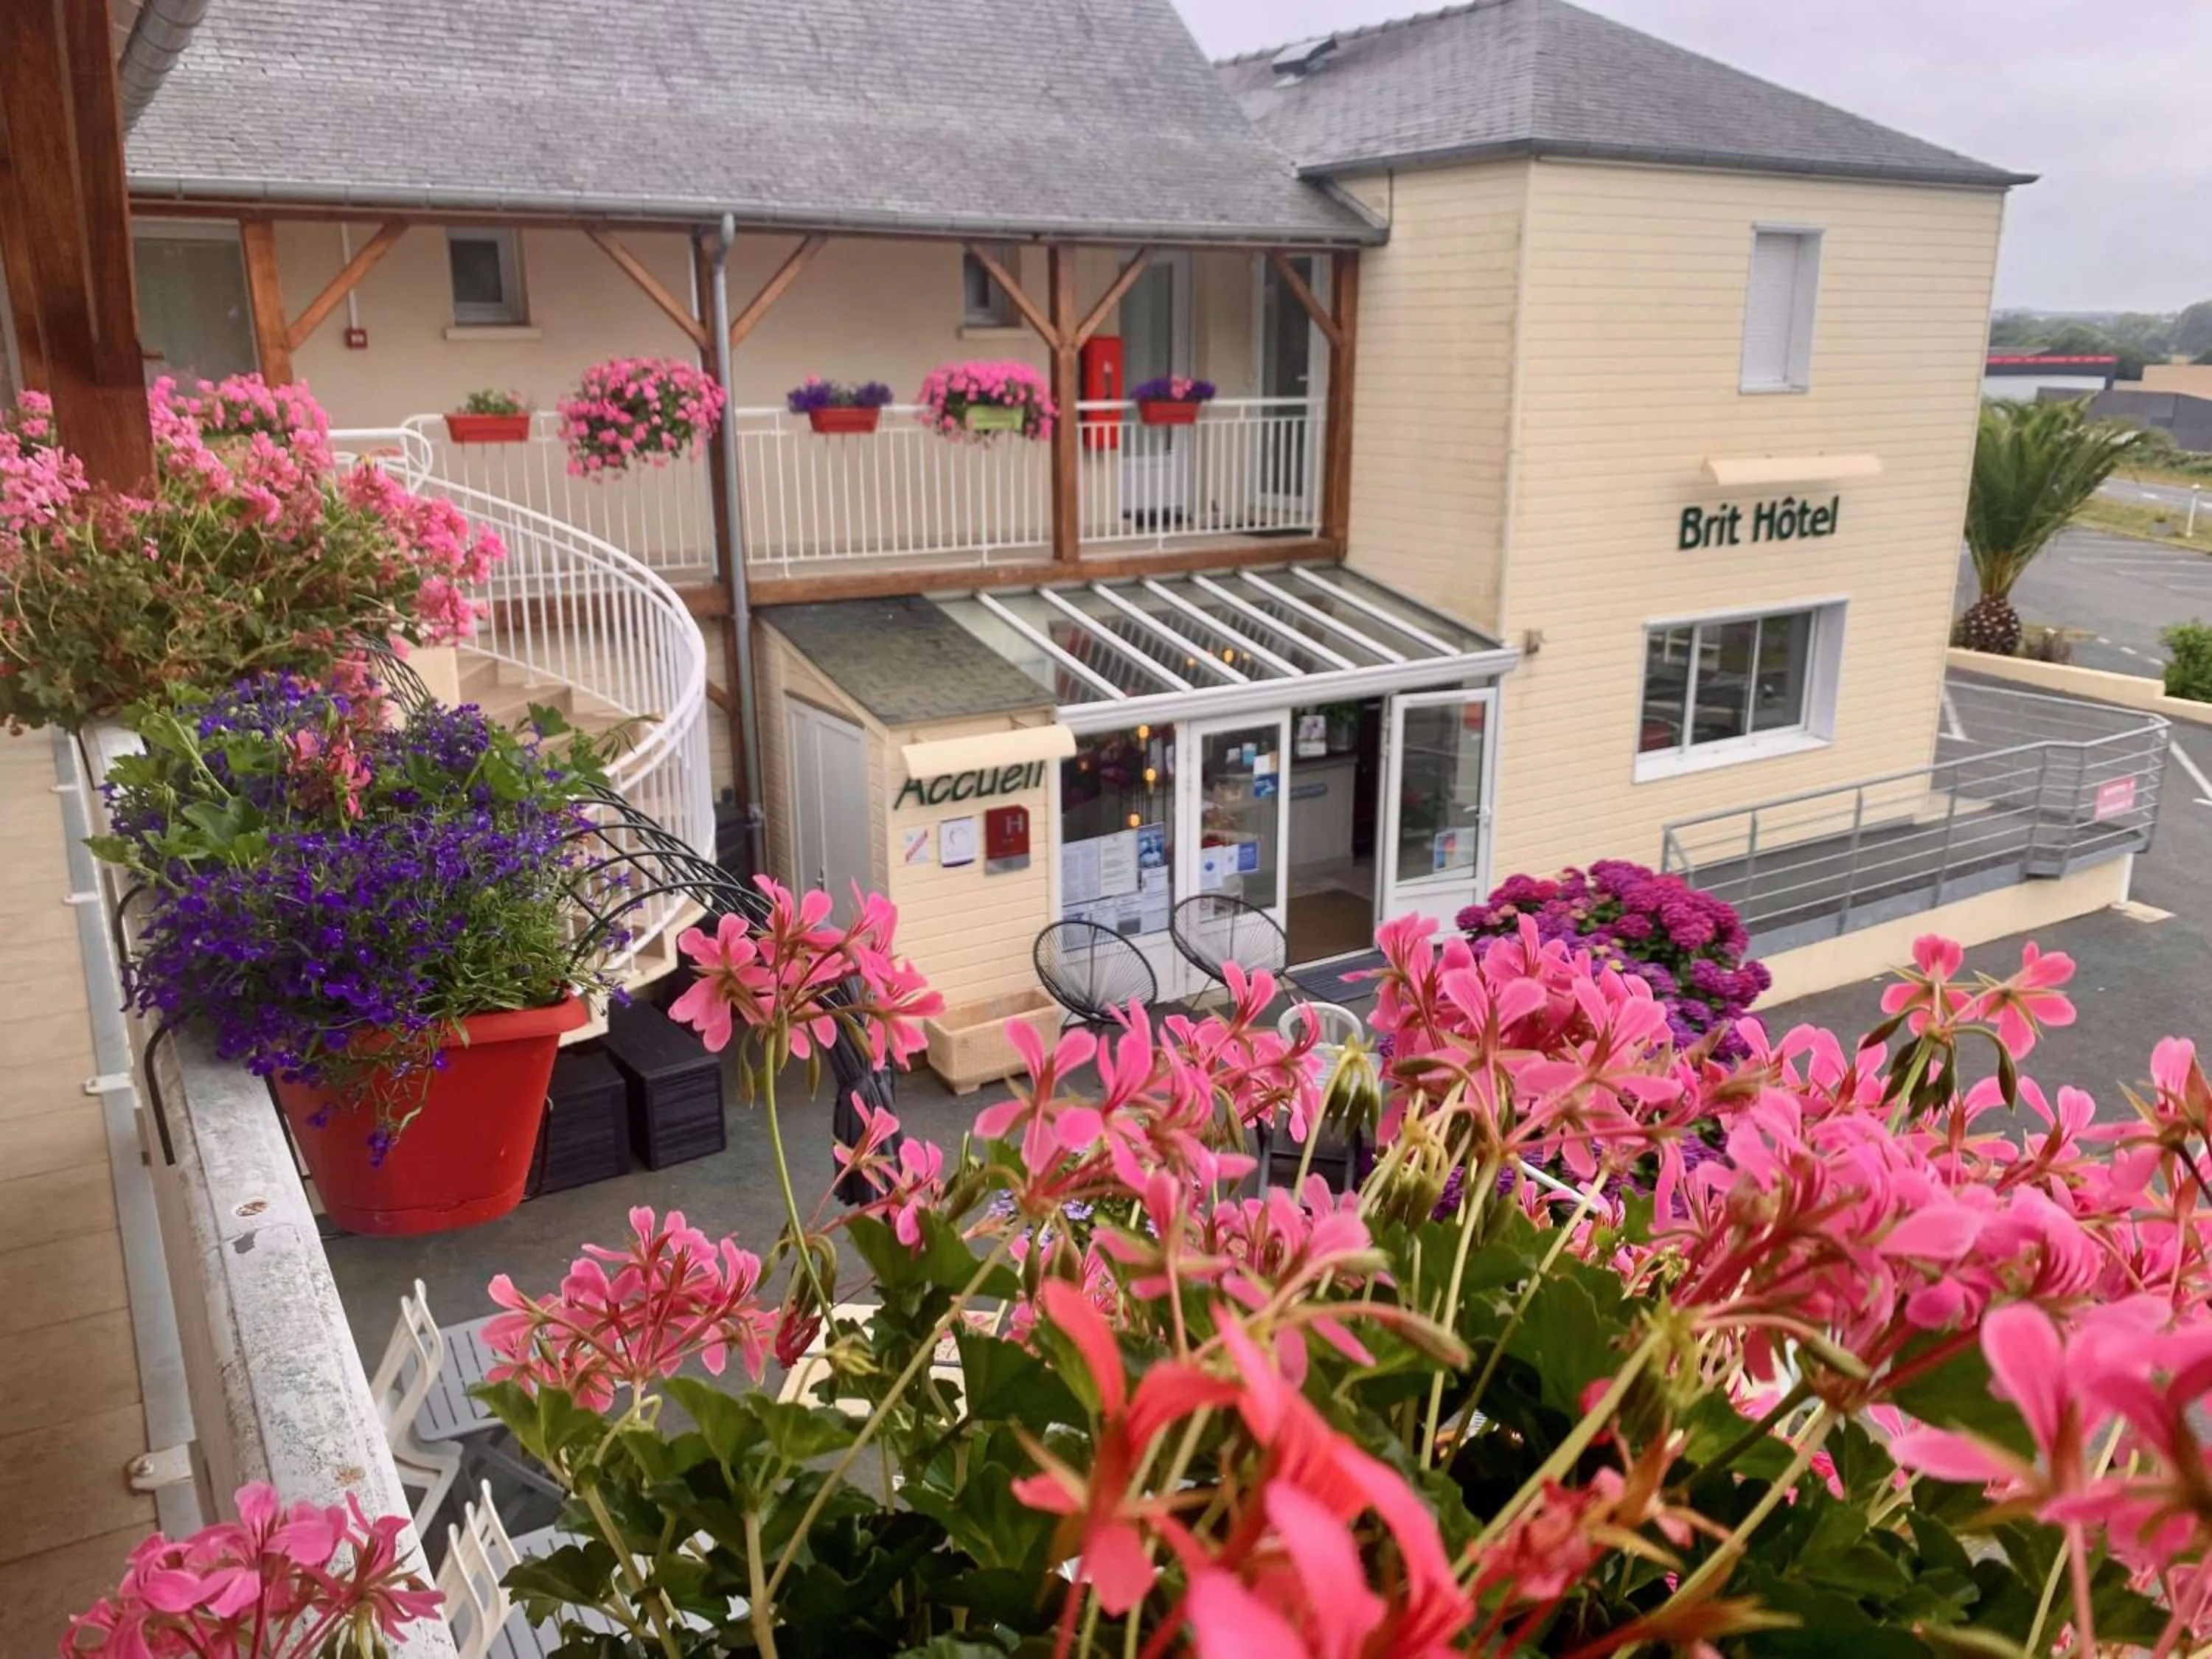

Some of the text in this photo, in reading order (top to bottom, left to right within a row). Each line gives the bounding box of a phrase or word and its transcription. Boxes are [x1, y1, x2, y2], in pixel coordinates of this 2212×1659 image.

[1678, 495, 1840, 550] Brit Hôtel
[893, 759, 1045, 810] Accueil
[1005, 813, 1024, 835] H
